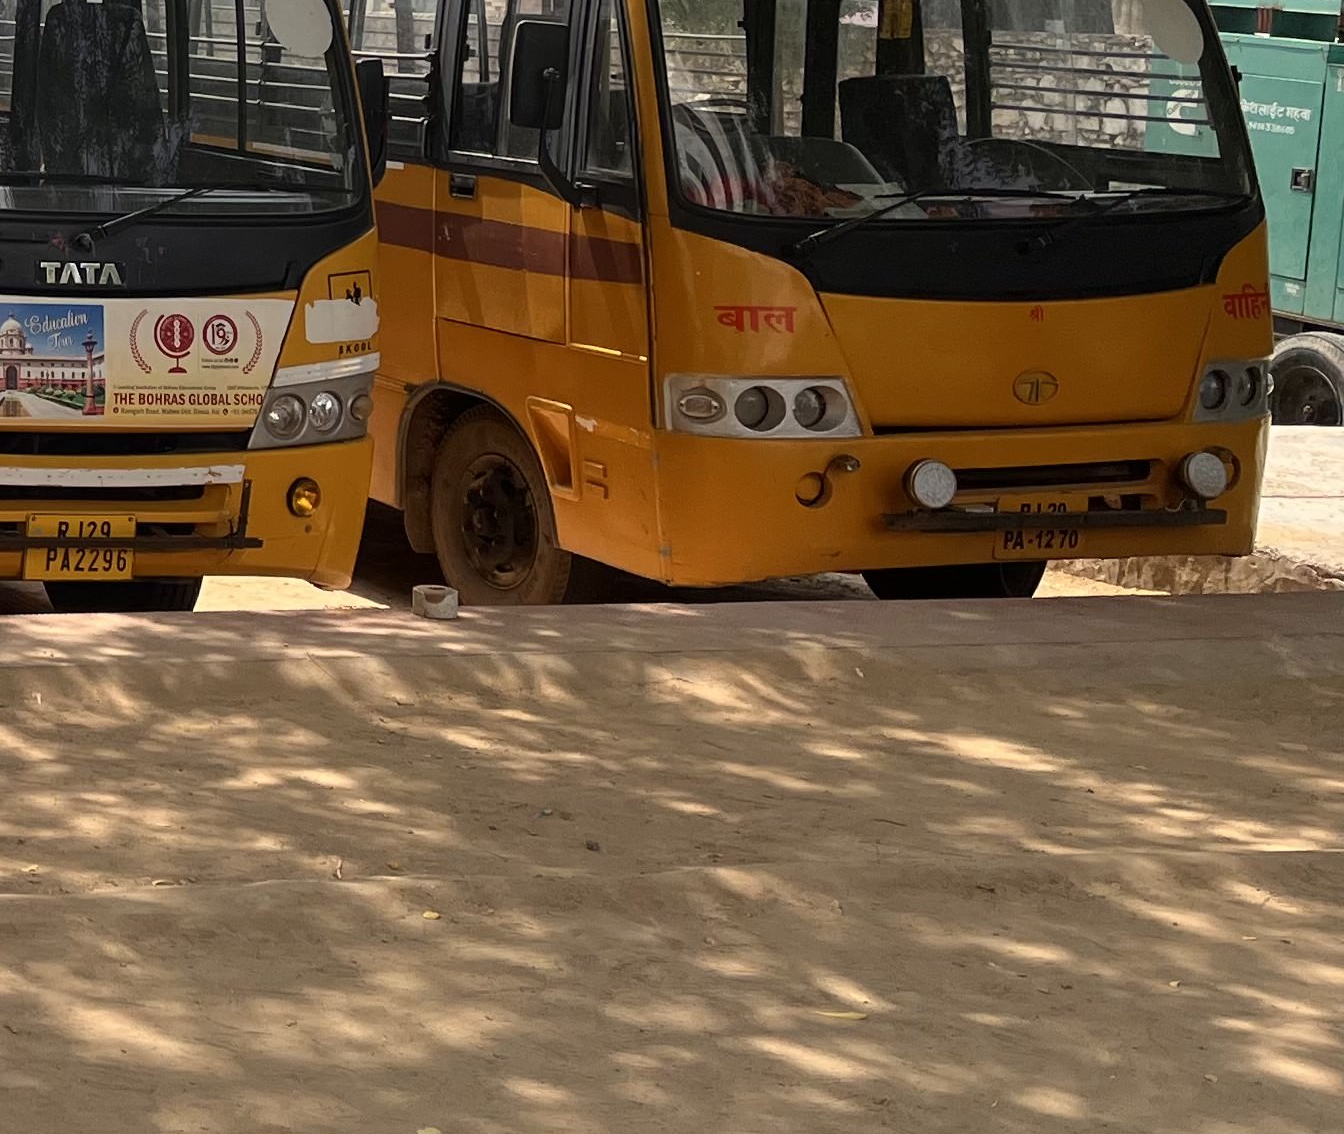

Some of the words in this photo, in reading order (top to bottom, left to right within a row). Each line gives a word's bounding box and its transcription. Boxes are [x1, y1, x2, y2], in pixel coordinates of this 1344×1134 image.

[40, 261, 122, 285] TATA
[24, 309, 89, 336] Education
[713, 305, 798, 334] बाल
[338, 341, 372, 355] SKOOL
[113, 392, 135, 405] THE
[138, 392, 186, 406] BOHRAS
[188, 393, 231, 406] GLOBAL
[45, 547, 127, 572] PA2296
